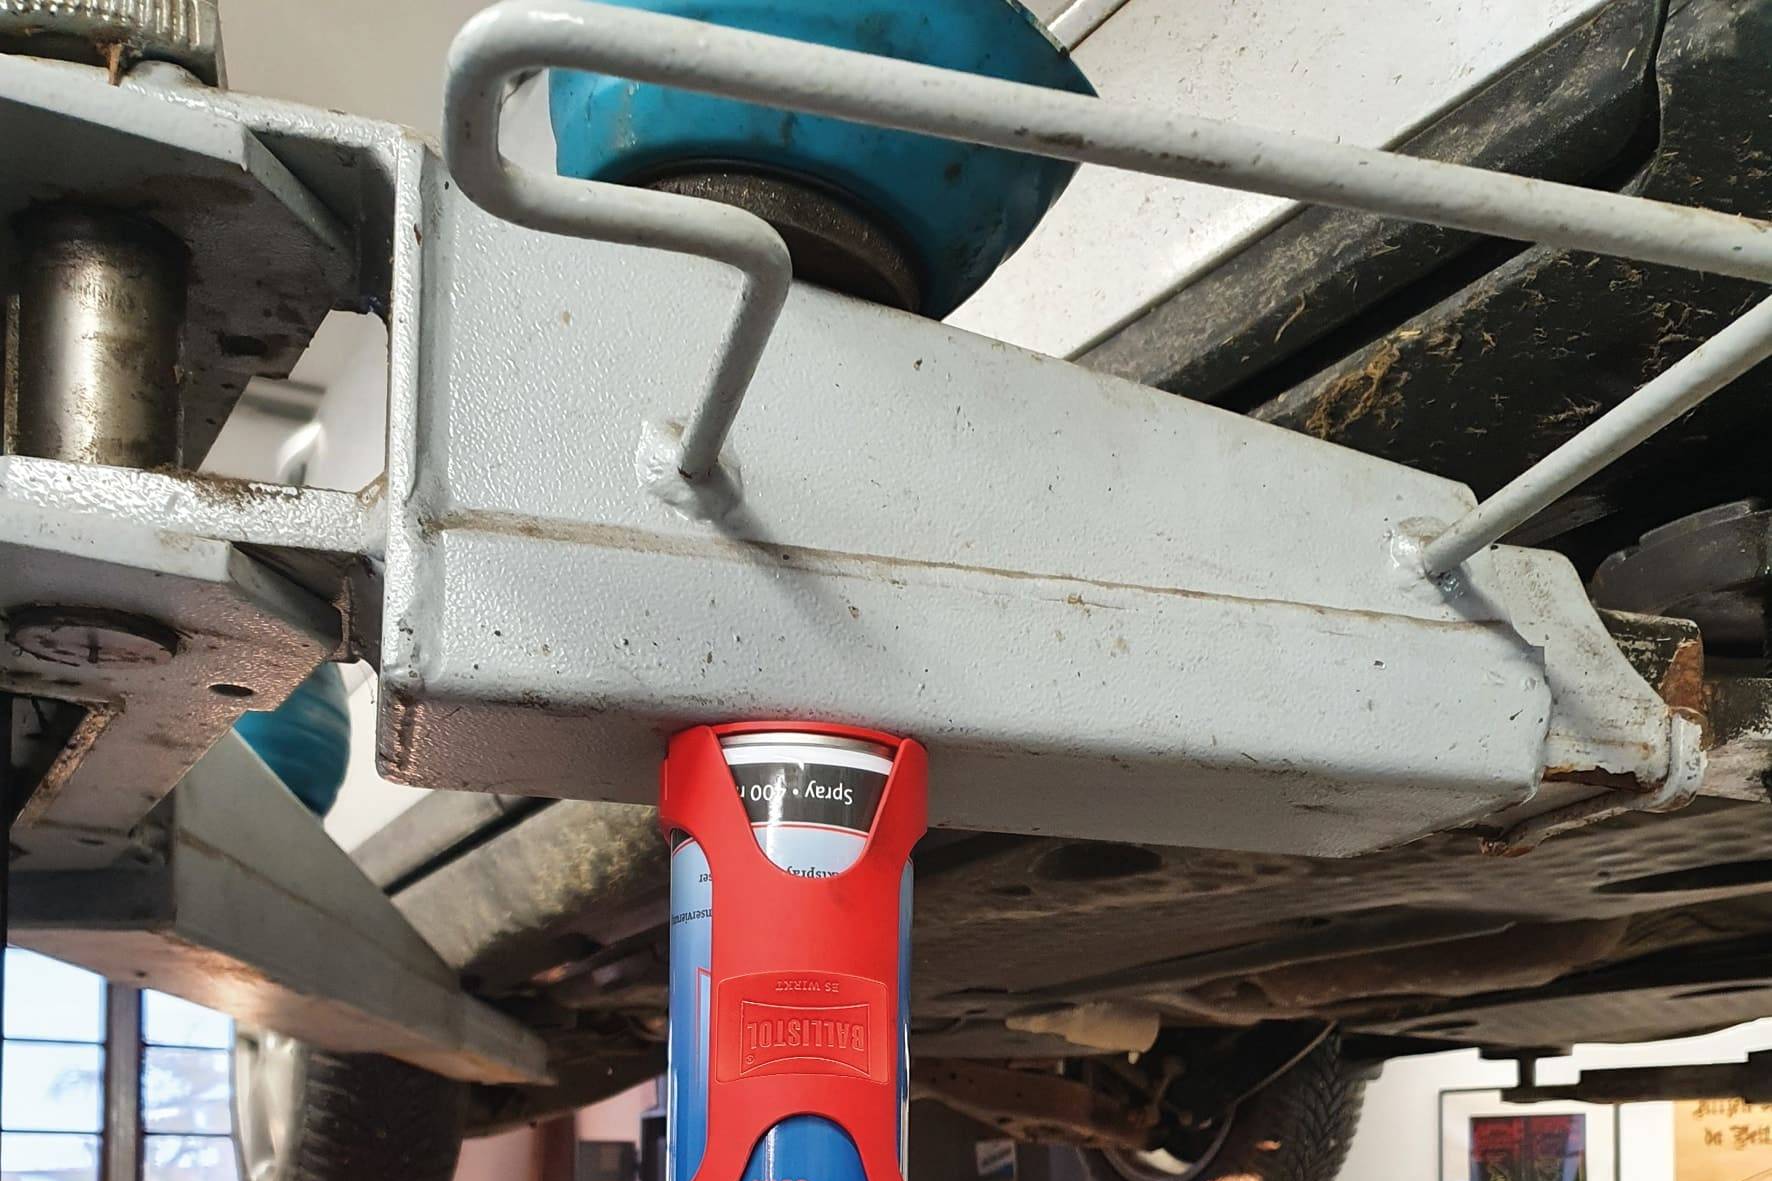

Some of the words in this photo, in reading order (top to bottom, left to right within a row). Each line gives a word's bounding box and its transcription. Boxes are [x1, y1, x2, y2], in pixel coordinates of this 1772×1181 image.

[804, 780, 854, 805] Spray
[775, 979, 821, 992] WIRKT
[825, 981, 840, 993] ES
[746, 1018, 865, 1053] BALLISTOL
